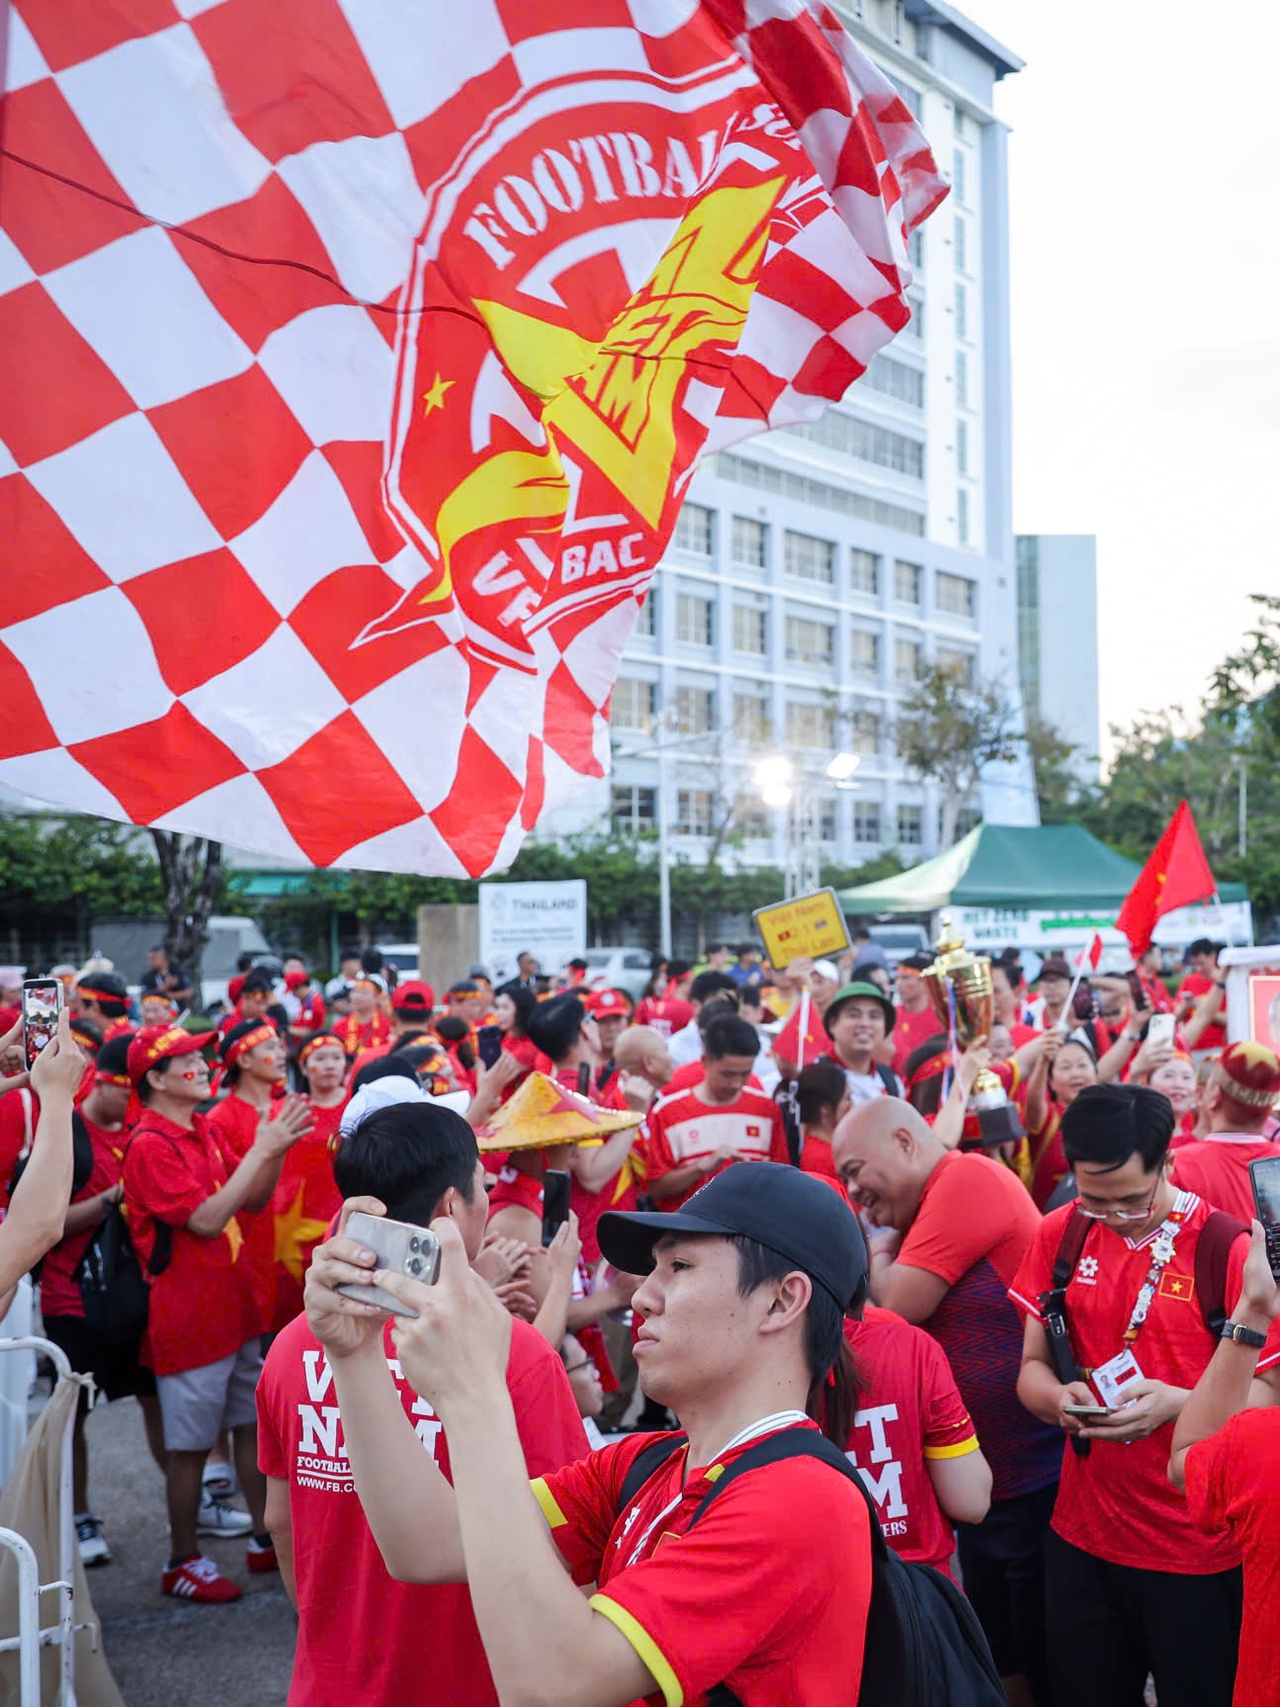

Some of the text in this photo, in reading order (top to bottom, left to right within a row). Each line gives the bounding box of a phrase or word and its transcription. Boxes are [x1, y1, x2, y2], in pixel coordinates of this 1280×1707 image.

[463, 120, 727, 270] FOOTBAL
[973, 927, 1019, 939] WASTE
[296, 1455, 351, 1473] FOOTBAL
[296, 1476, 359, 1493] WWW.FB.C
